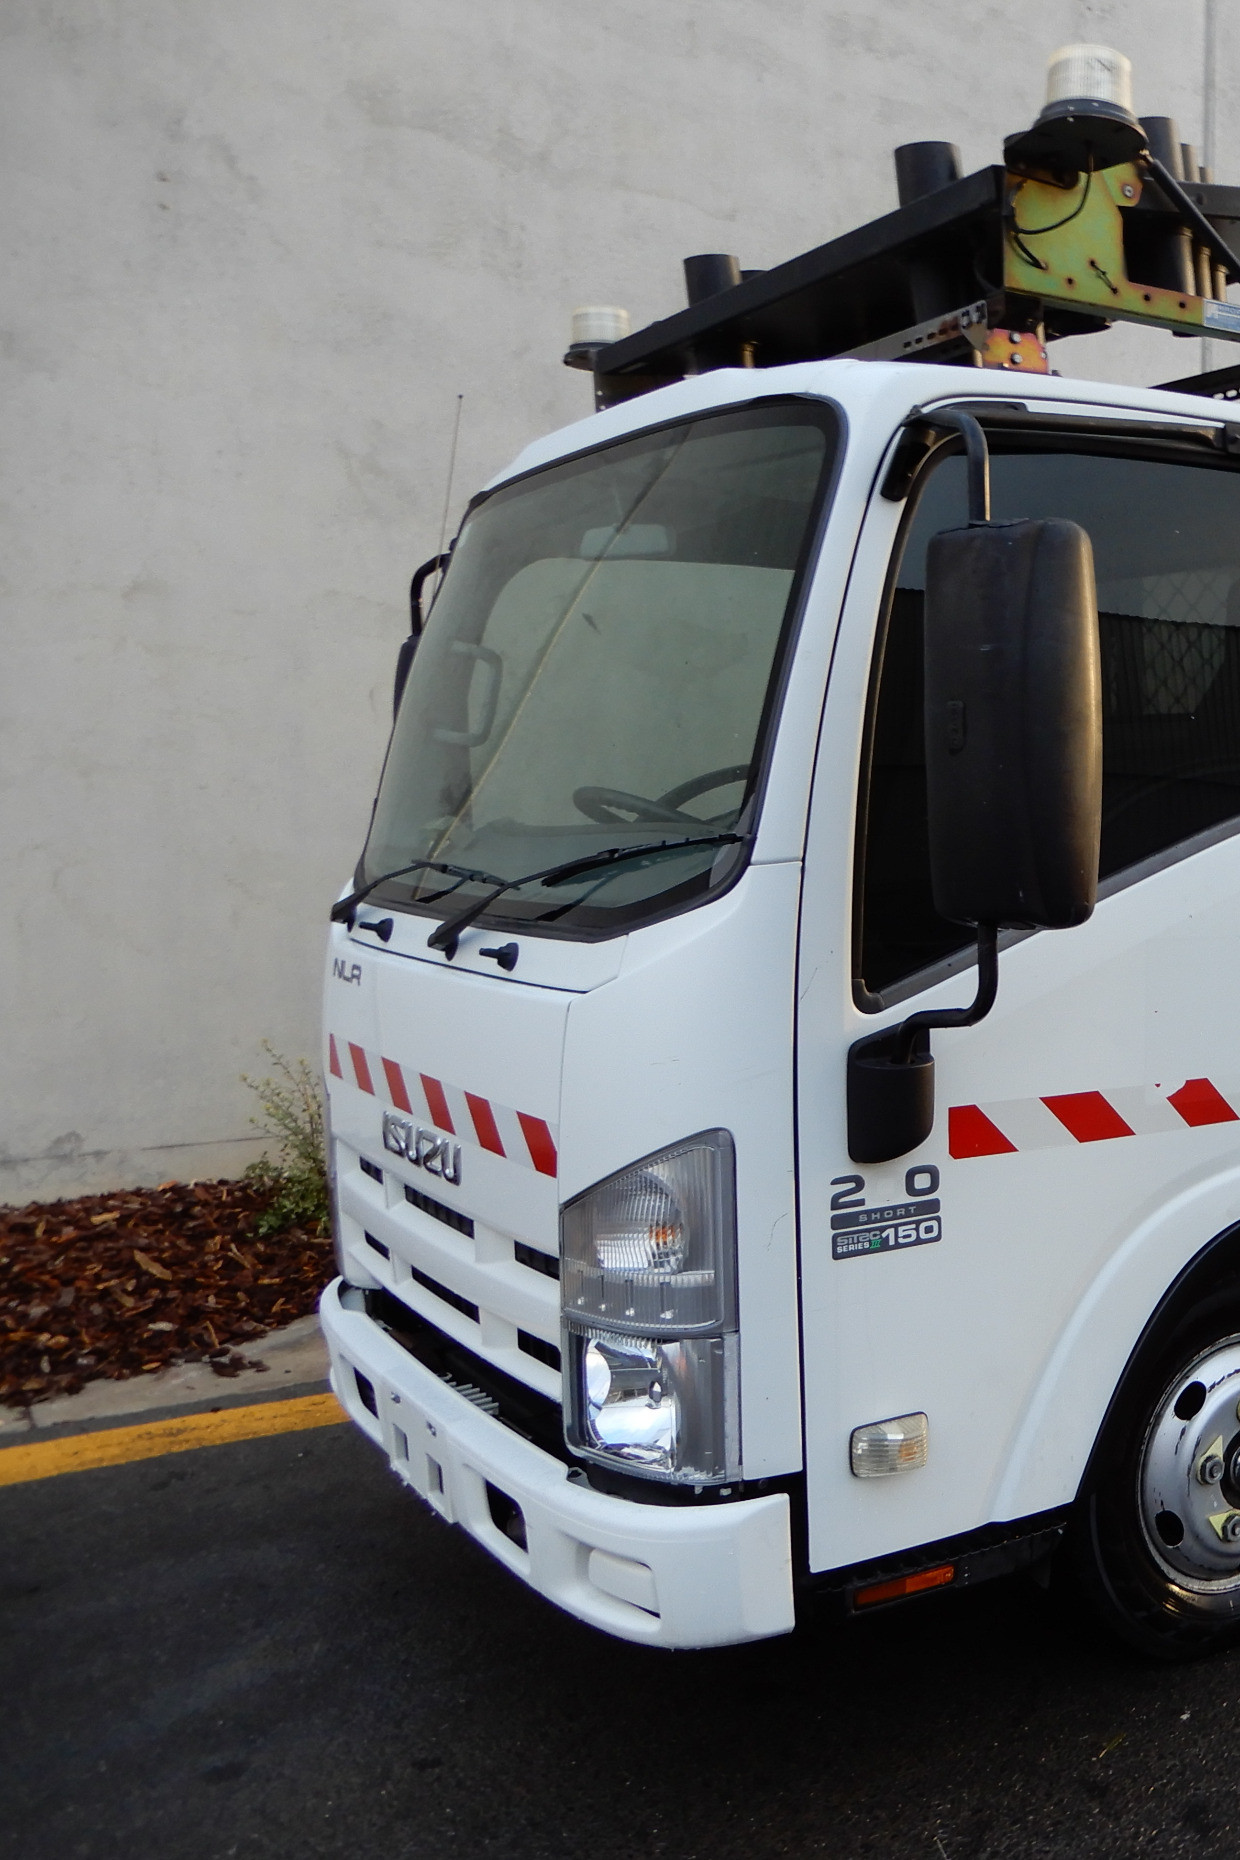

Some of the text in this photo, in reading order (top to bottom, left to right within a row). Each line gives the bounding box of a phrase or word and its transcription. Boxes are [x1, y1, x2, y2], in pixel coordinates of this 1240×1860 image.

[333, 957, 362, 986] NLR
[383, 1110, 463, 1186] ISUZU
[859, 1206, 916, 1222] SHORT
[882, 1220, 939, 1245] 150
[837, 1241, 870, 1253] SERIES
